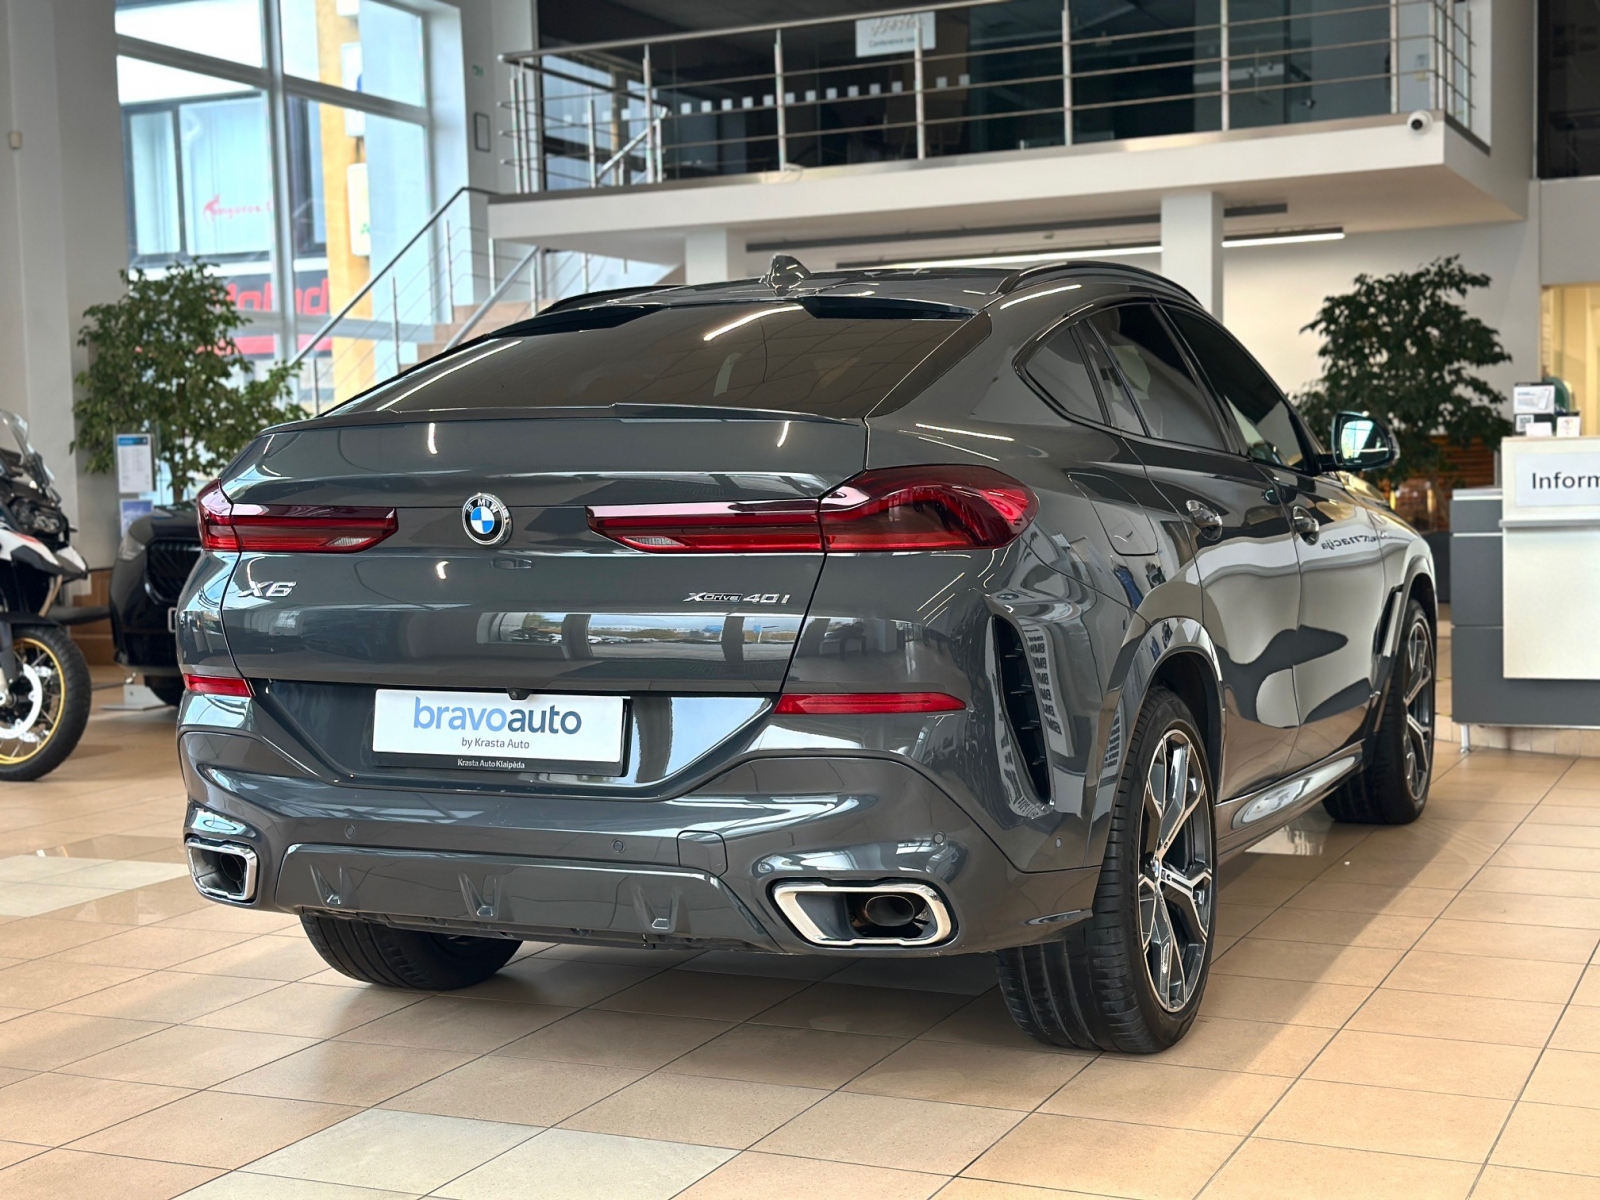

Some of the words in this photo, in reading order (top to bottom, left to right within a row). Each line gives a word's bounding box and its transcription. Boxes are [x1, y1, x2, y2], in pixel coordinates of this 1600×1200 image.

[466, 498, 499, 513] BMW
[237, 581, 297, 597] X6
[413, 696, 582, 735] bravoauto
[461, 737, 473, 748] by
[474, 737, 505, 748] Krasta
[507, 739, 530, 749] Auto
[457, 758, 479, 767] Krasta
